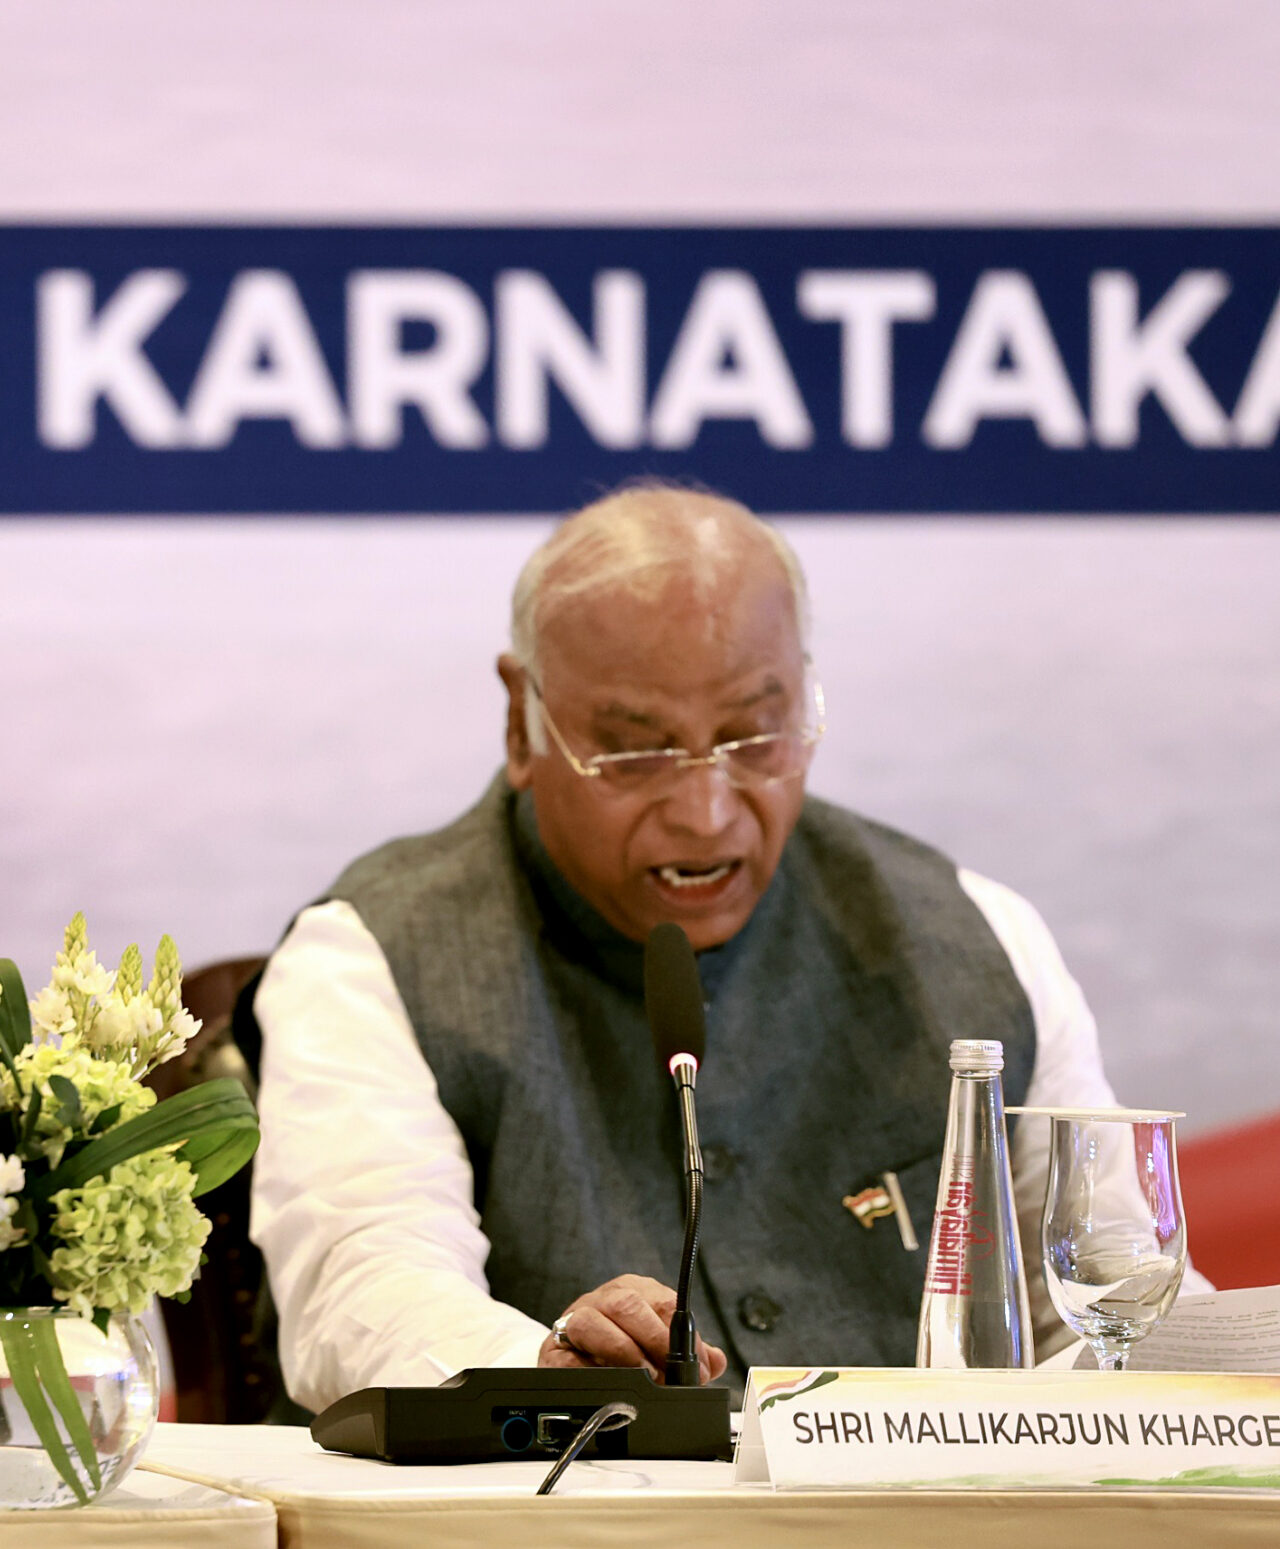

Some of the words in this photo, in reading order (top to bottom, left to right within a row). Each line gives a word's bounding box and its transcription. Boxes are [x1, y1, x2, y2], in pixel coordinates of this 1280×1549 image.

[792, 1411, 874, 1445] SHRI
[883, 1411, 1131, 1446] MALLIKARJUN
[1138, 1413, 1280, 1447] KHARGE
